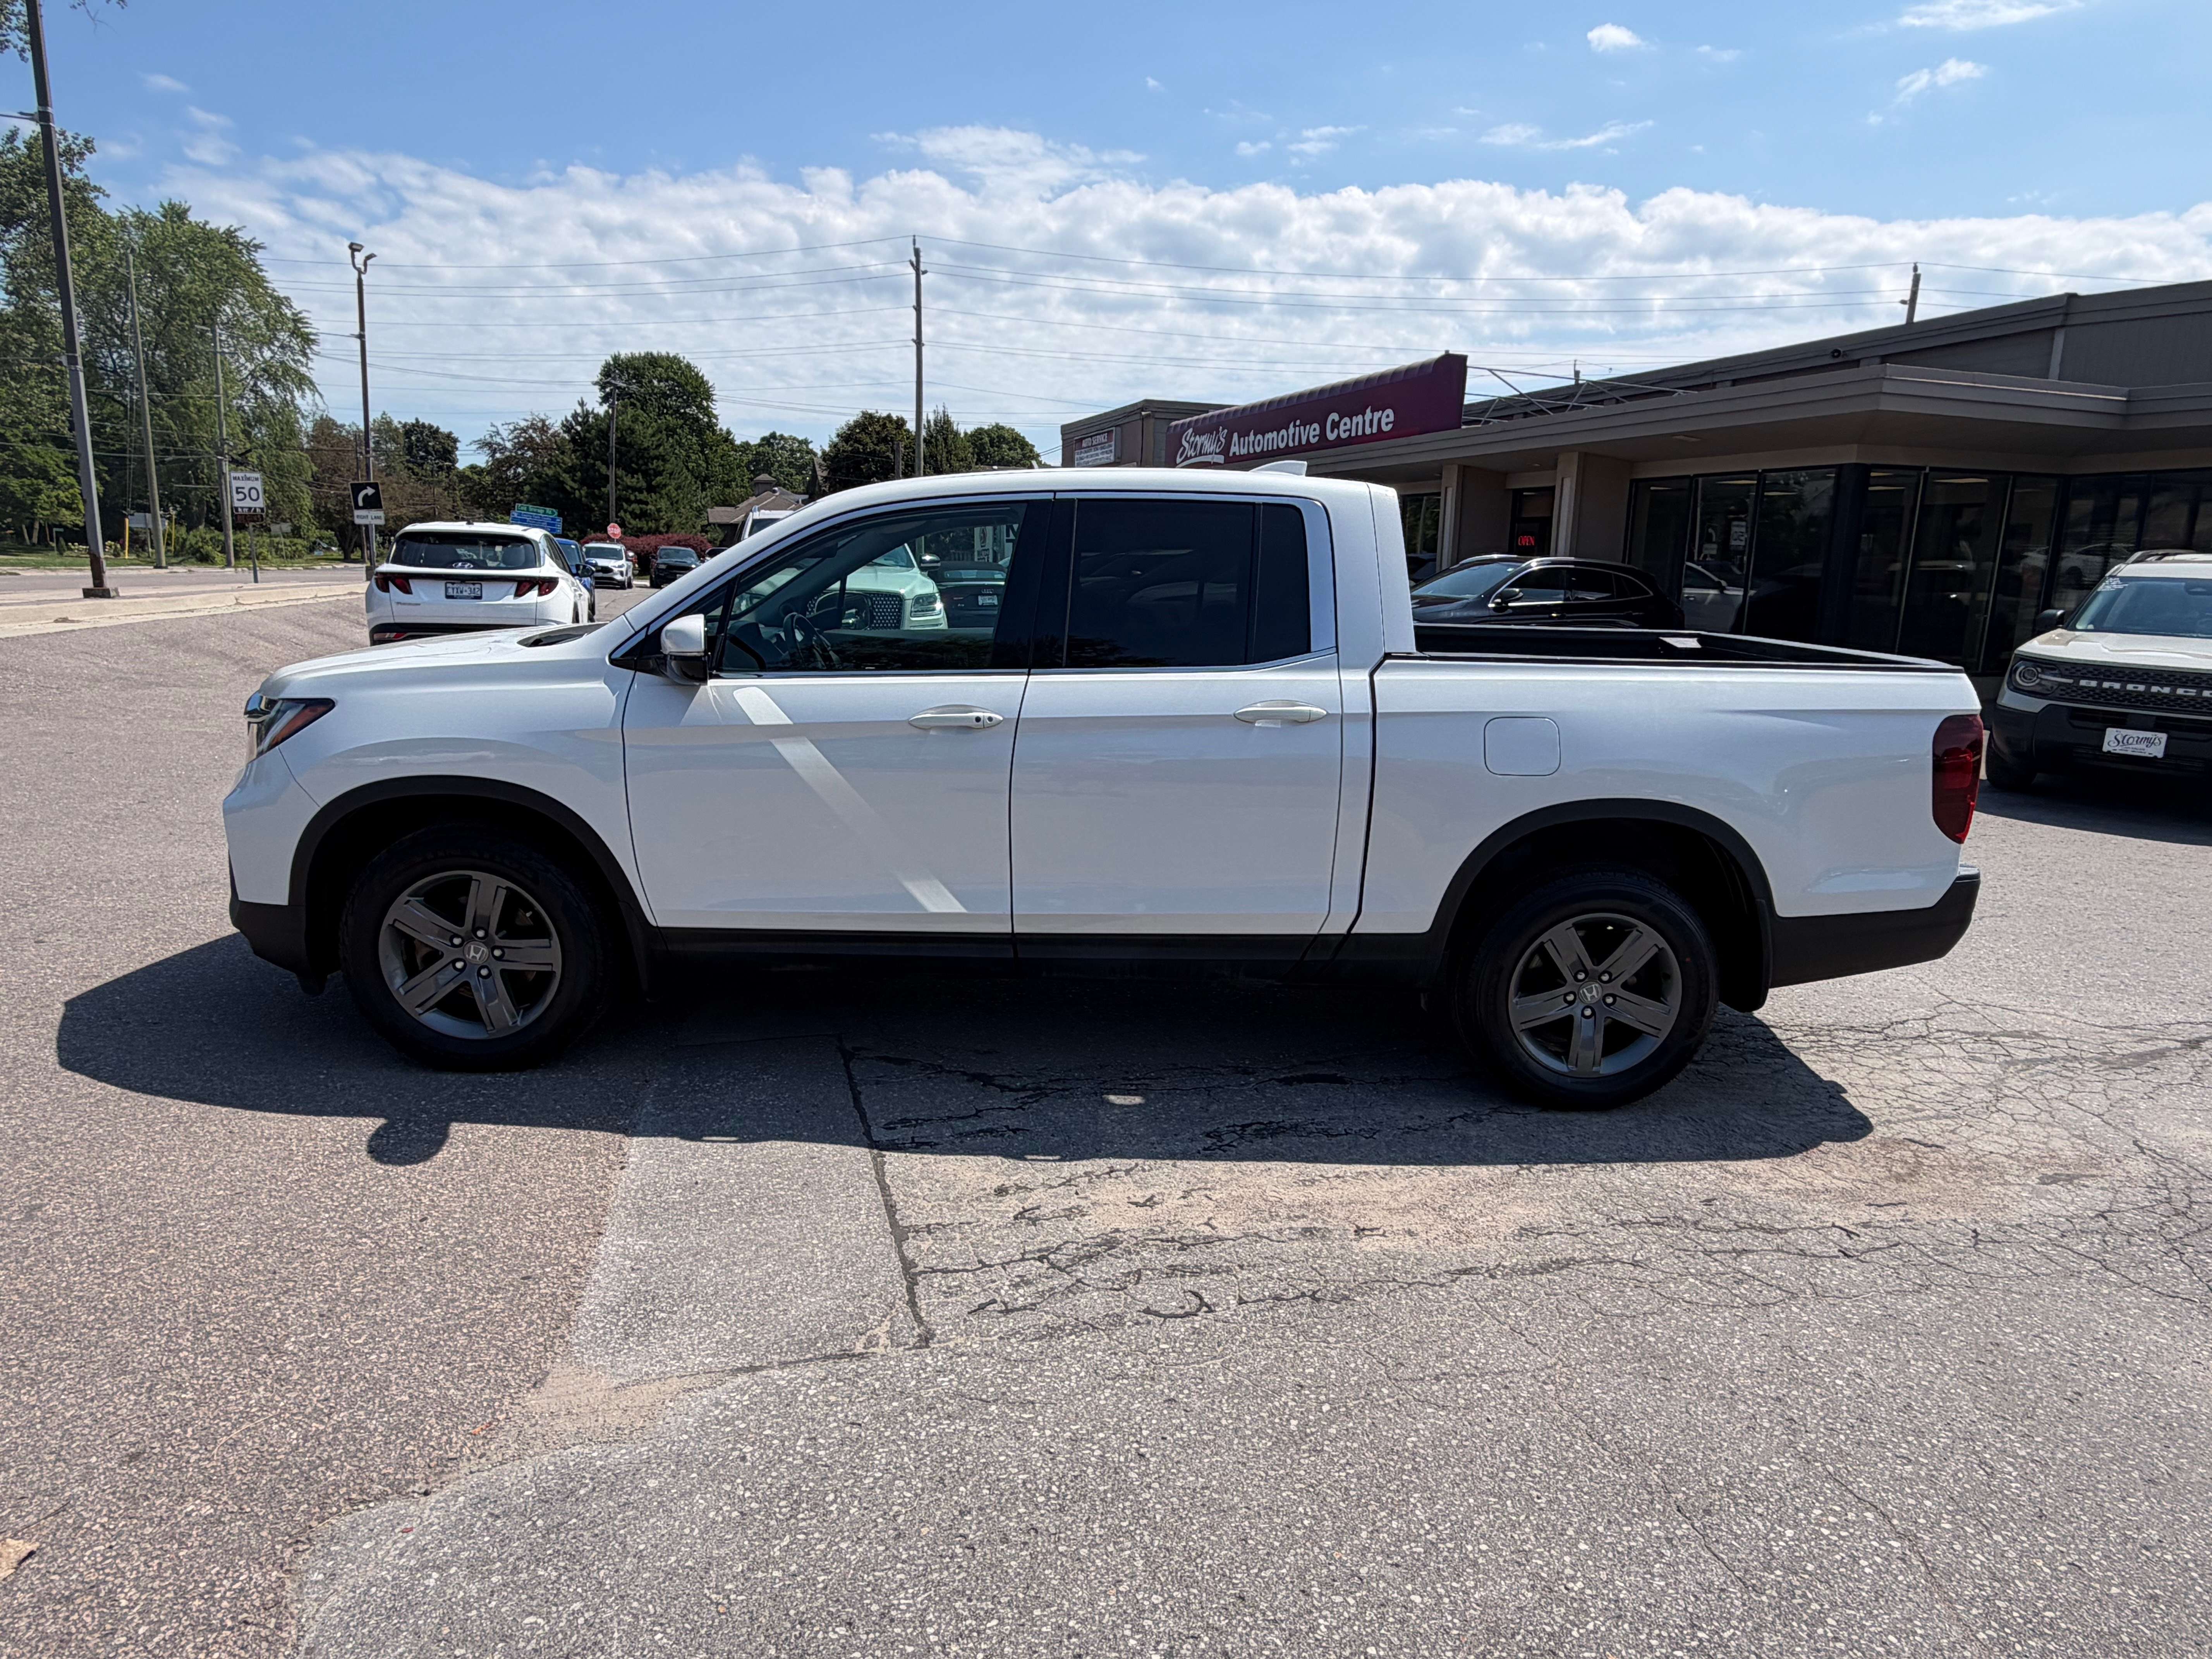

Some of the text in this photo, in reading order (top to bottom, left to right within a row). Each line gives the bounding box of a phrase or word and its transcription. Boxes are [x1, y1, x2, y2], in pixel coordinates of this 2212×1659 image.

[1092, 433, 1108, 446] SERVICE
[1176, 406, 1395, 464] Stormy's Automotive Centre
[235, 486, 260, 501] 50
[1518, 536, 1535, 546] OPEN
